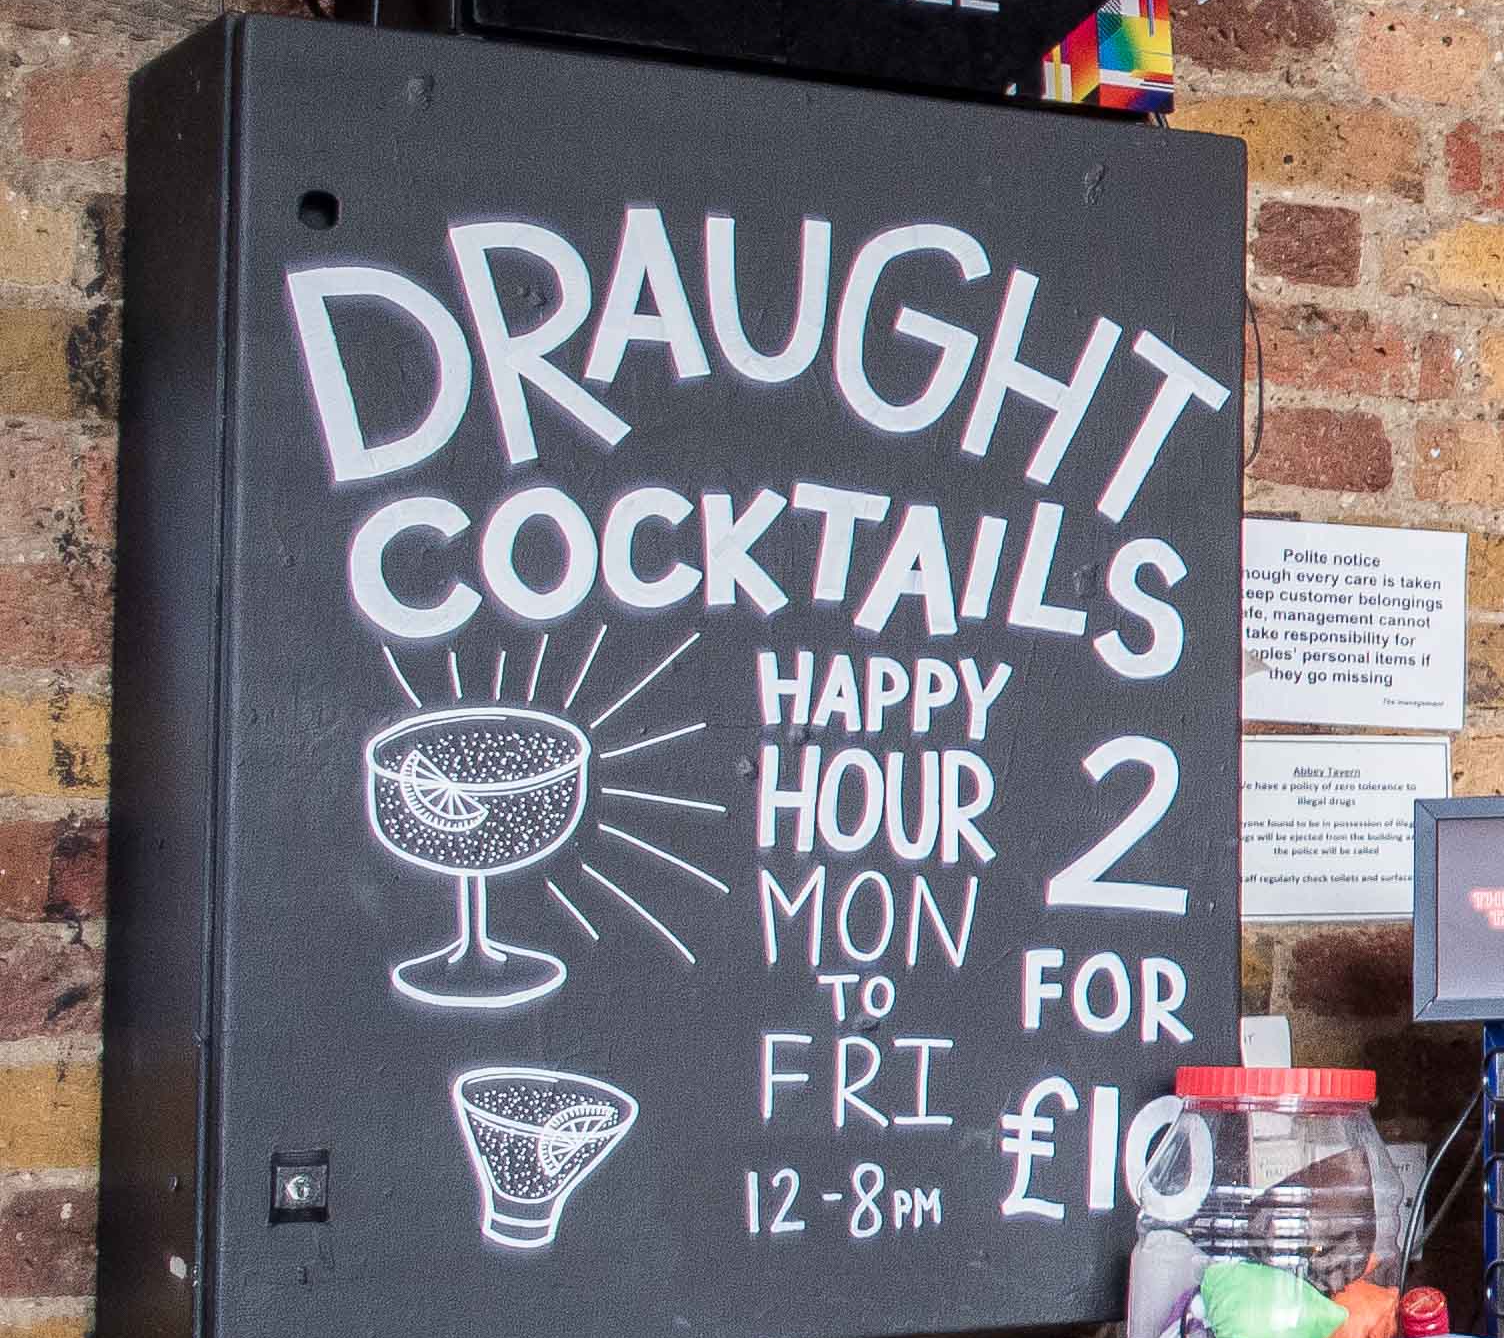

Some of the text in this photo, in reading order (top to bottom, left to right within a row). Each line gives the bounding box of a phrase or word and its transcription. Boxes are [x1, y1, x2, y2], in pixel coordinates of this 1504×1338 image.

[285, 206, 1232, 523] DRAUGHT
[346, 481, 1189, 681] COCKTAILS
[1283, 548, 1381, 567] Polite notice
[1296, 572, 1441, 590] every care is taken
[1273, 609, 1431, 629] management cannot
[1280, 589, 1443, 612] customer belongings
[1246, 627, 1416, 649] take responsibility for
[1303, 649, 1431, 667] personal items if
[757, 650, 1013, 741] HAPPY
[1269, 667, 1393, 687] they go missing
[1255, 780, 1279, 790] have
[1290, 780, 1319, 792] policy
[1406, 781, 1417, 791] to
[756, 734, 1191, 917] HOUR 2
[757, 864, 980, 969] MON
[817, 948, 1194, 1044] TO FOR
[760, 1032, 954, 1130] FRI
[1000, 1074, 1216, 1223] £10
